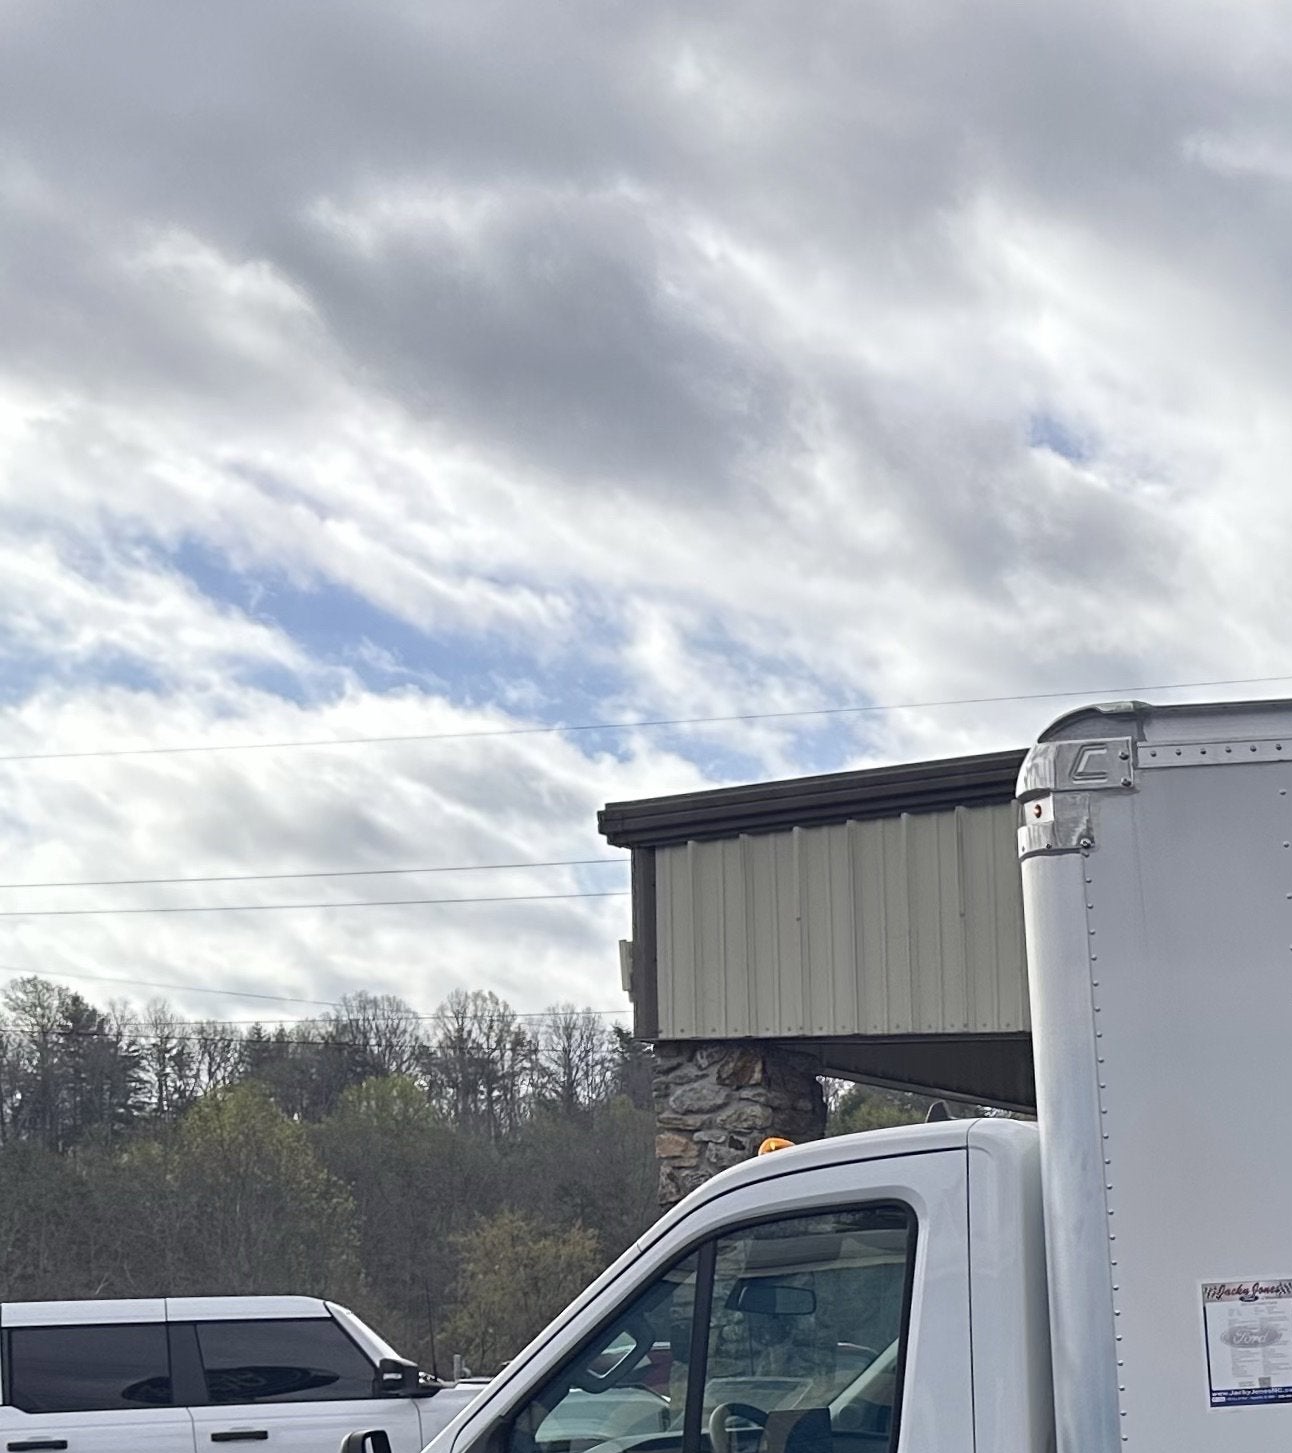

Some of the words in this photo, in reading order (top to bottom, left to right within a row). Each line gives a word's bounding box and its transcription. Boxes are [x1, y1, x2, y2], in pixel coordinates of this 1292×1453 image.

[1215, 1283, 1250, 1300] Jacky
[1251, 1281, 1281, 1298] Jones
[1232, 1328, 1270, 1345] Ford
